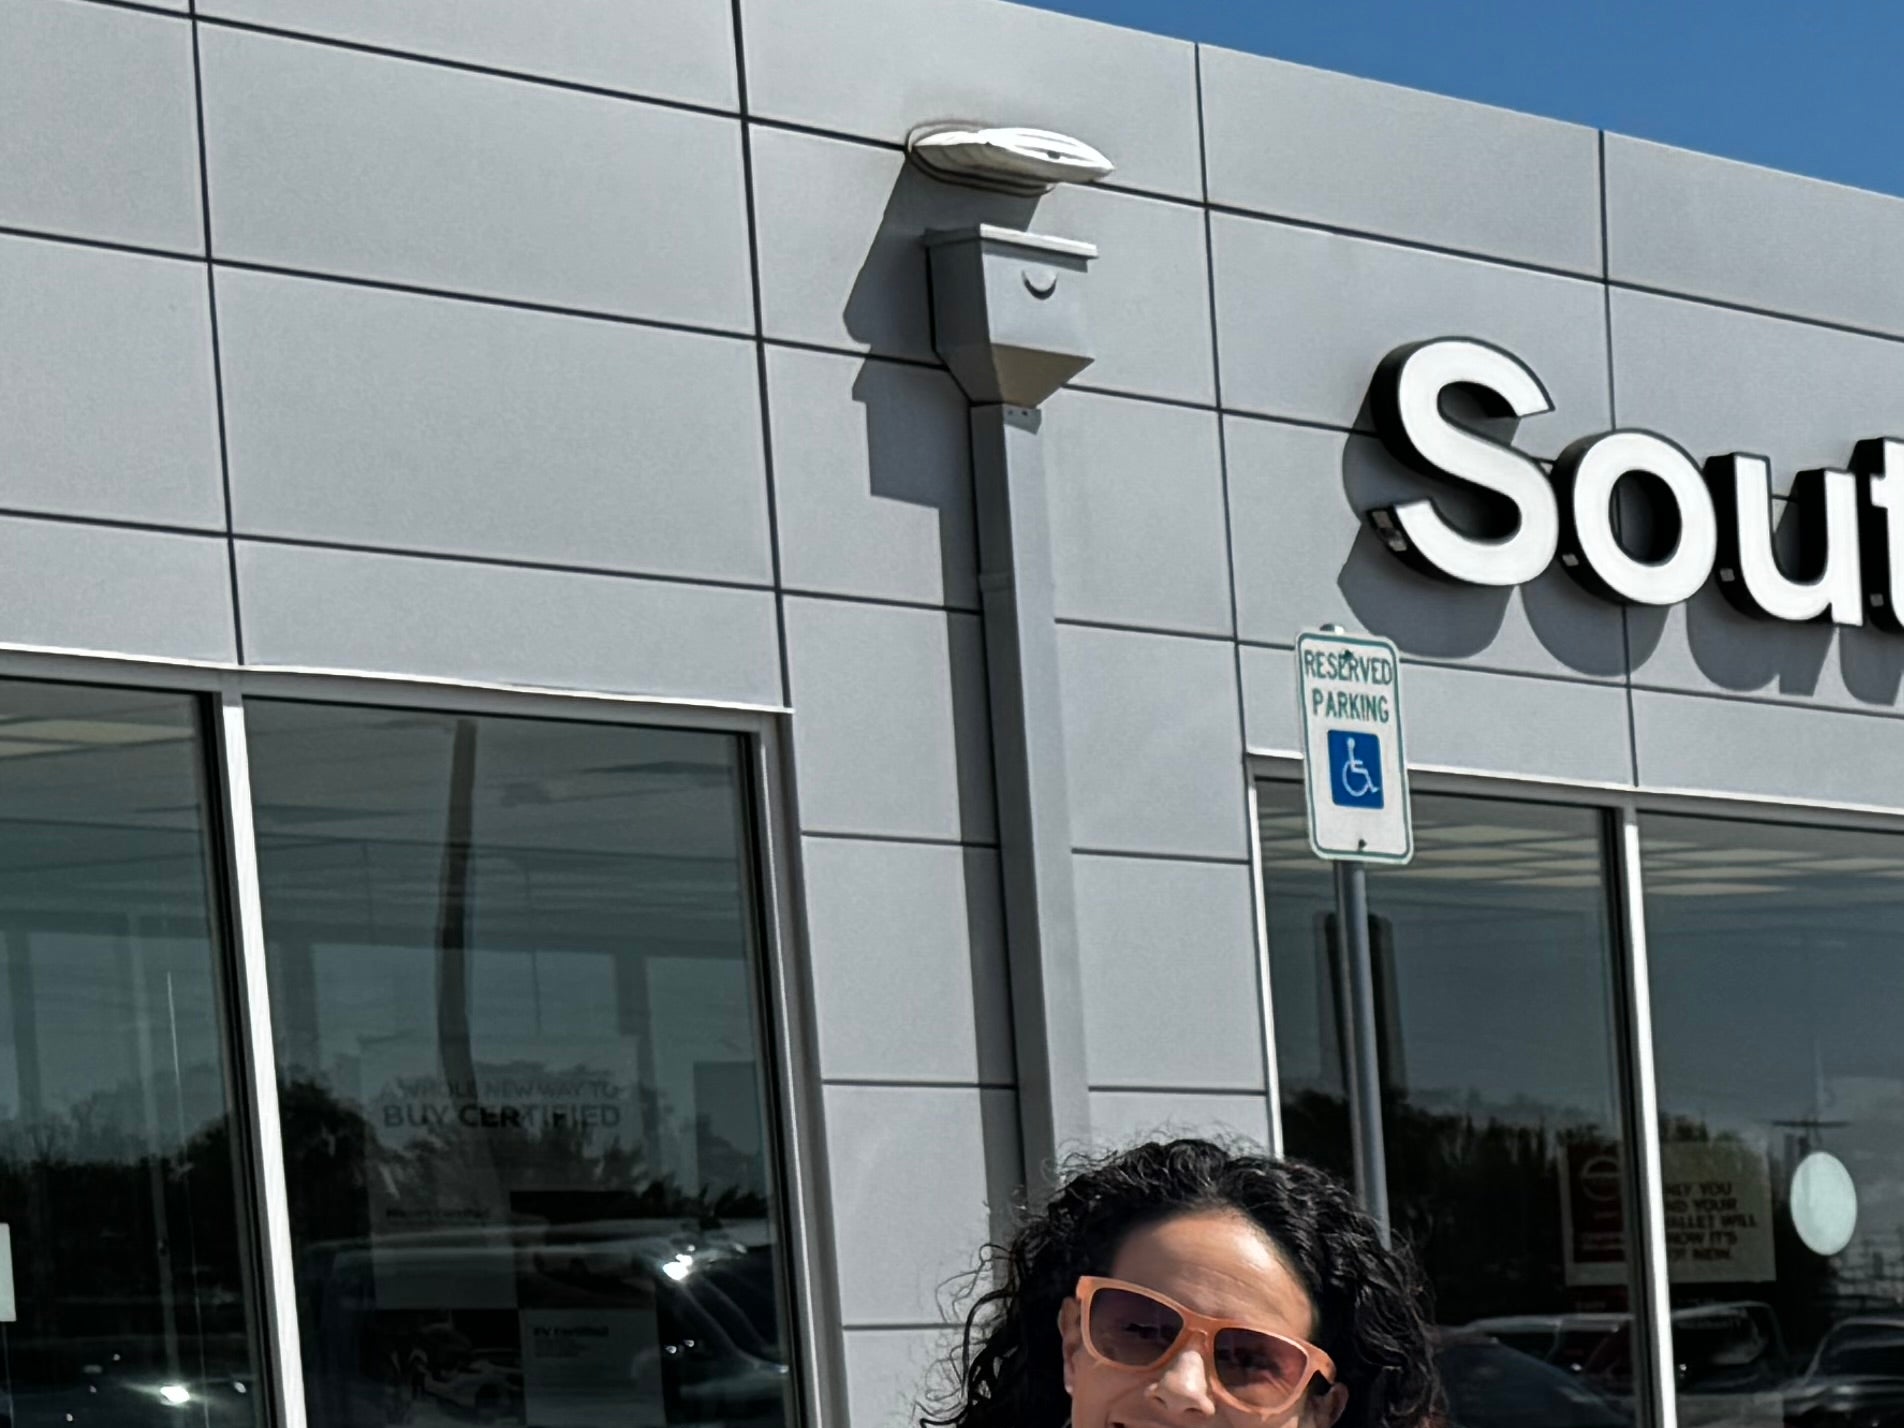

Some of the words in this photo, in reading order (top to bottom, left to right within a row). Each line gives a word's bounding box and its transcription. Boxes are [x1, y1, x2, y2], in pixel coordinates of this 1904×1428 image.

[1303, 649, 1393, 685] RESERVED
[1311, 688, 1390, 723] PARKING
[383, 1105, 449, 1128] BUY
[458, 1104, 621, 1128] CERTIFIED
